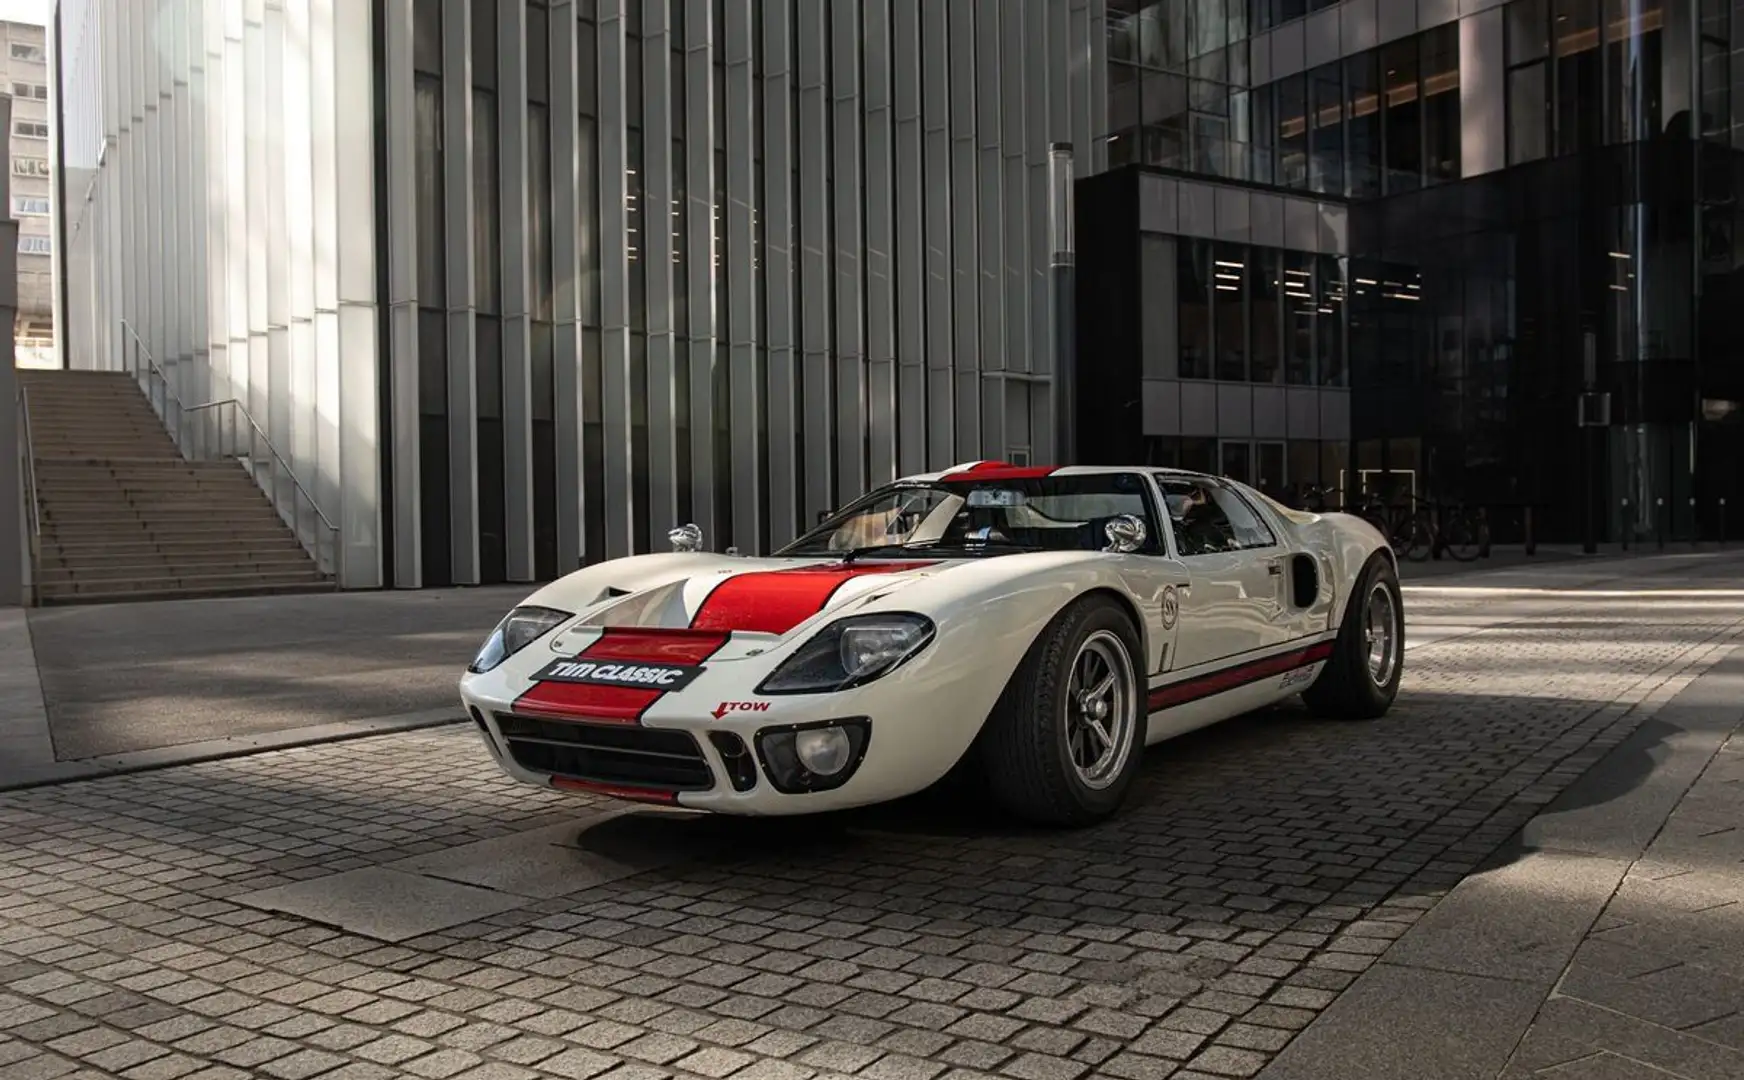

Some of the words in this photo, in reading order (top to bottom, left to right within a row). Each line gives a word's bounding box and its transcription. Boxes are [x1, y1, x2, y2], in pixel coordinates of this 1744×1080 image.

[549, 662, 597, 678] TIM
[592, 664, 684, 685] CLASSIC
[729, 702, 772, 712] TOW
